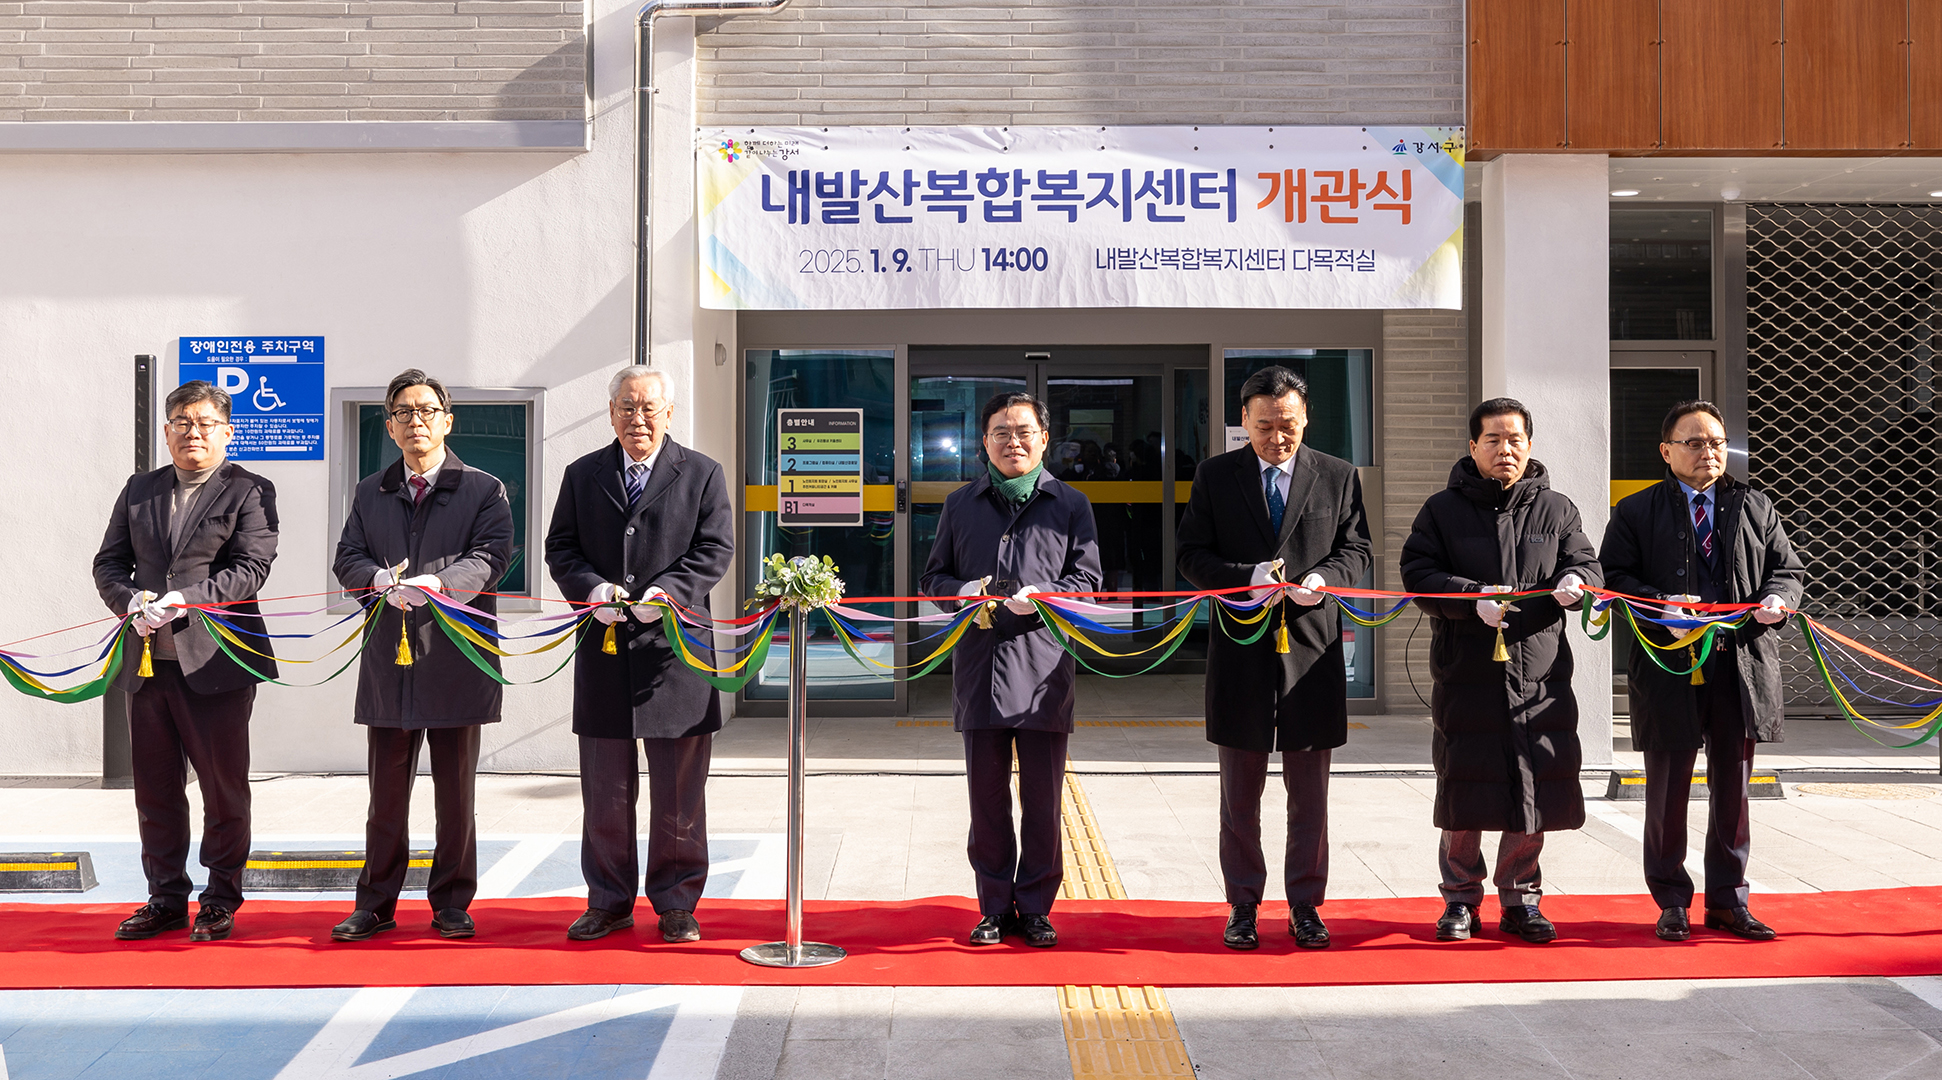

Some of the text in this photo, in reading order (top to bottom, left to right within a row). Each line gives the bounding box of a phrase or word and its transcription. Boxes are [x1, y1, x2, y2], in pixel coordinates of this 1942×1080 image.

[778, 148, 800, 161] 강서
[1412, 142, 1456, 154] 강서구
[761, 167, 1412, 225] 내발산복합복지센터 개관식
[798, 246, 1376, 274] 2025. 1. 9. THU 14:00 내발산복합복지센터 다목적실
[189, 340, 314, 354] 장애인전용 주차구역
[217, 366, 250, 395] P
[786, 418, 815, 427] 층별안내
[787, 436, 797, 450] 3
[787, 458, 797, 471] 2
[788, 479, 794, 493] 1
[784, 500, 798, 514] B1
